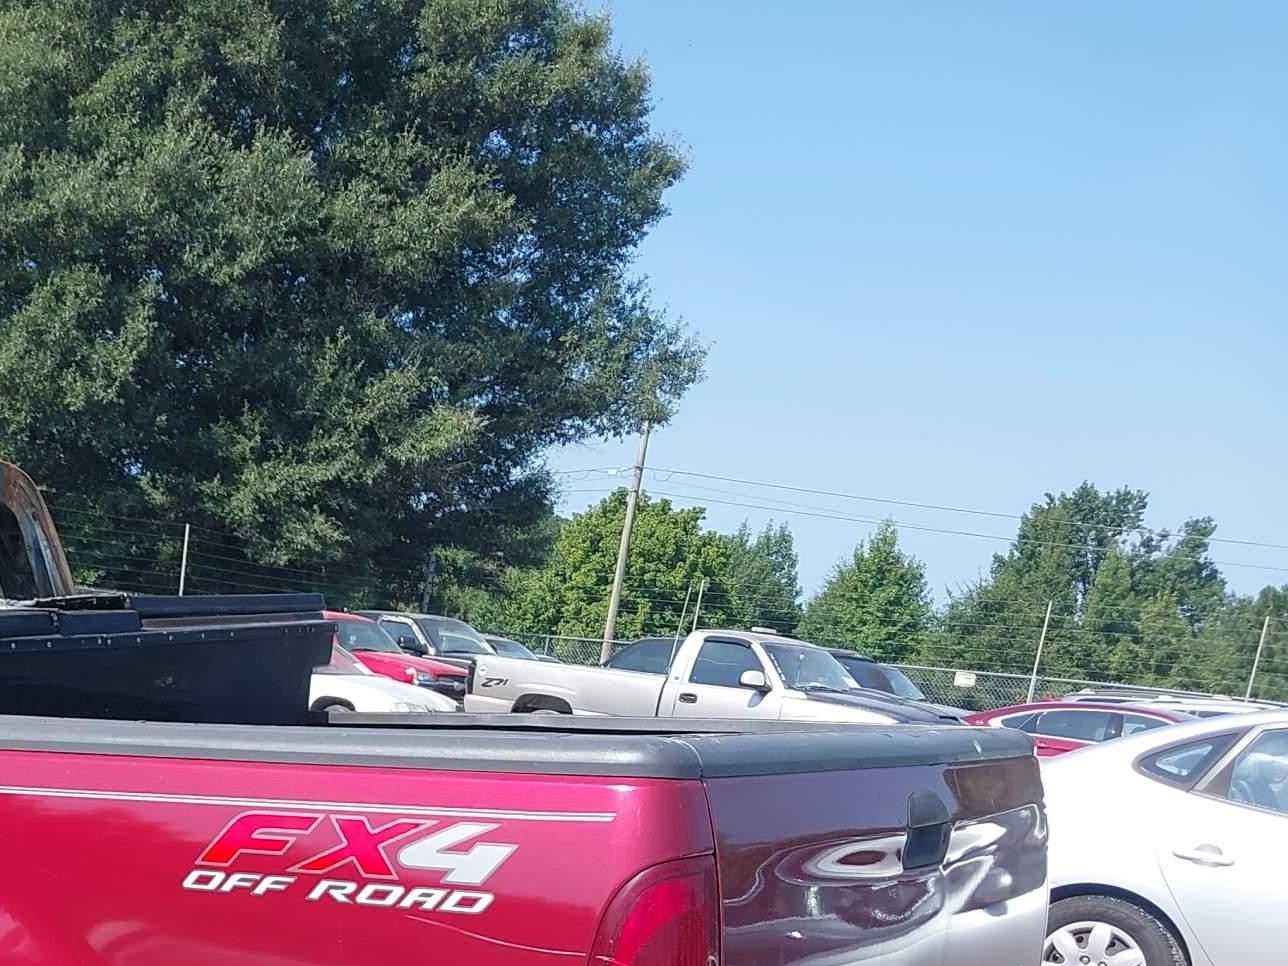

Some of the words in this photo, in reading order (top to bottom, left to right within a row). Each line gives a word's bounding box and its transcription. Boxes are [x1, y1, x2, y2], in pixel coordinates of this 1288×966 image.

[481, 677, 509, 688] Z71
[194, 810, 519, 886] FX4
[182, 869, 297, 896] OFF
[306, 878, 495, 915] ROAD
